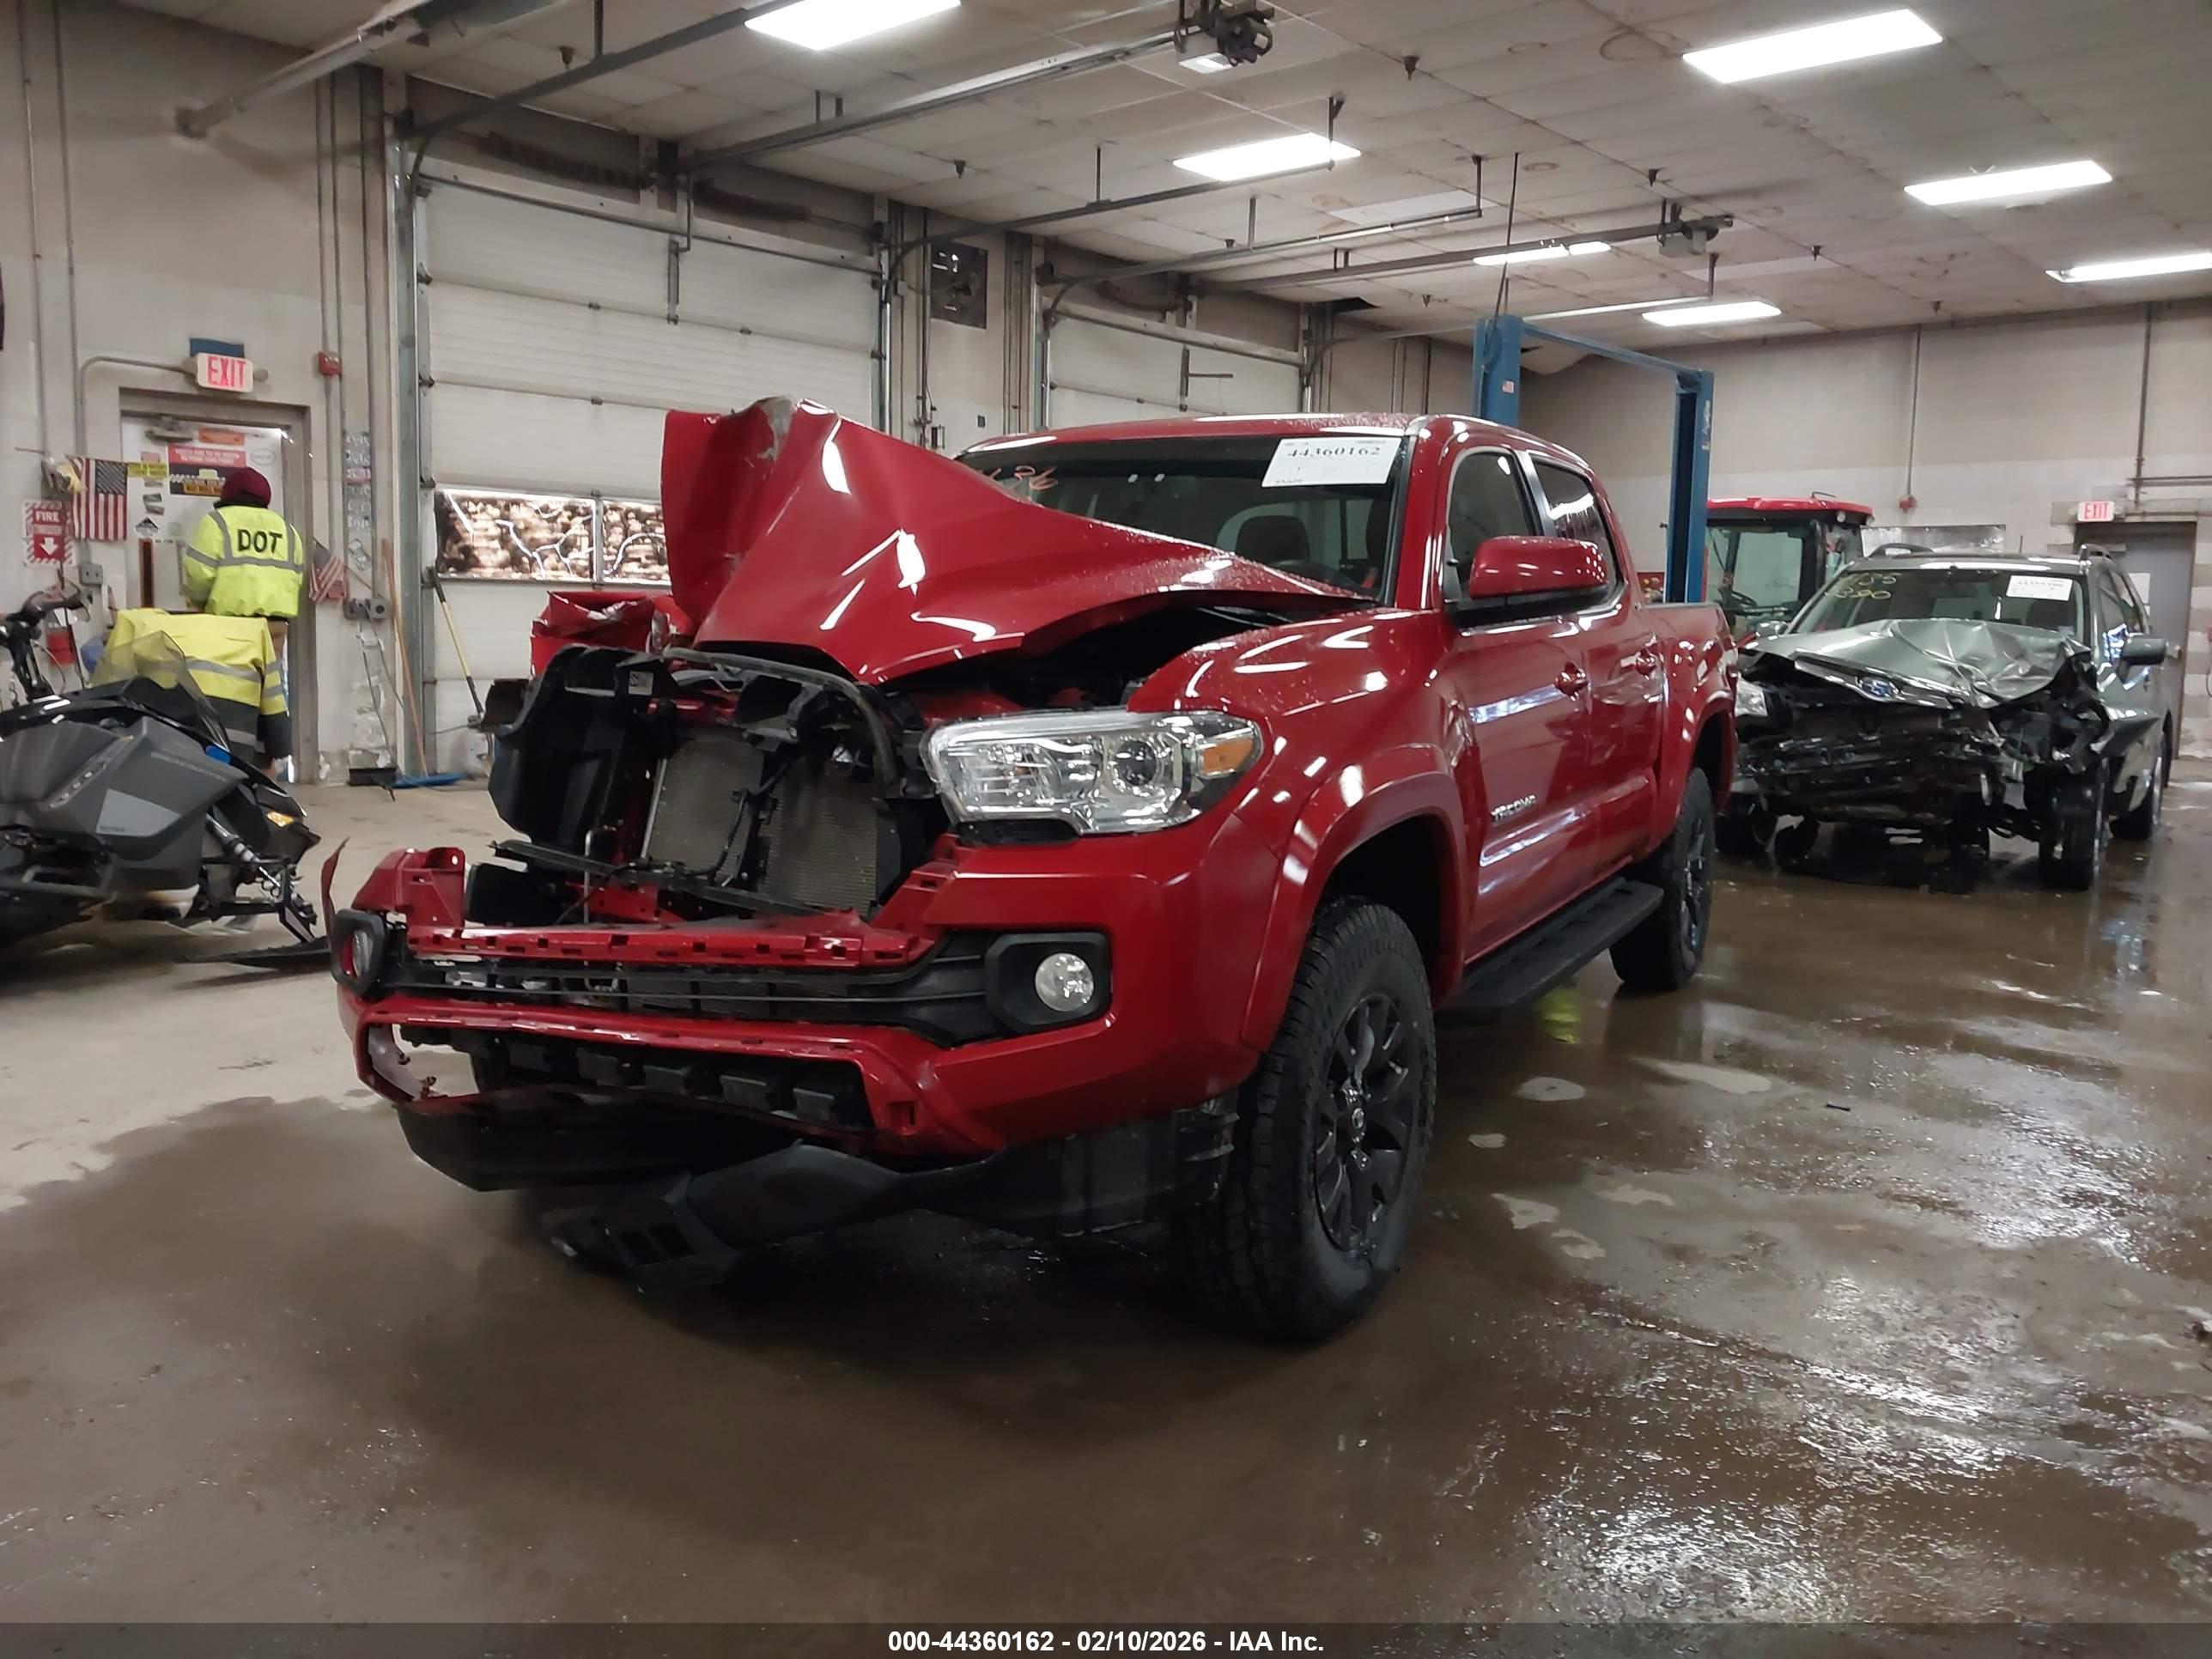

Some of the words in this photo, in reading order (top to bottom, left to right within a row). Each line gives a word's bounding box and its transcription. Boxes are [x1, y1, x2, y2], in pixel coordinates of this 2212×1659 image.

[208, 356, 246, 389] EXIT
[35, 511, 60, 522] FIRE
[2084, 501, 2110, 520] EXIT
[237, 528, 283, 555] DOT
